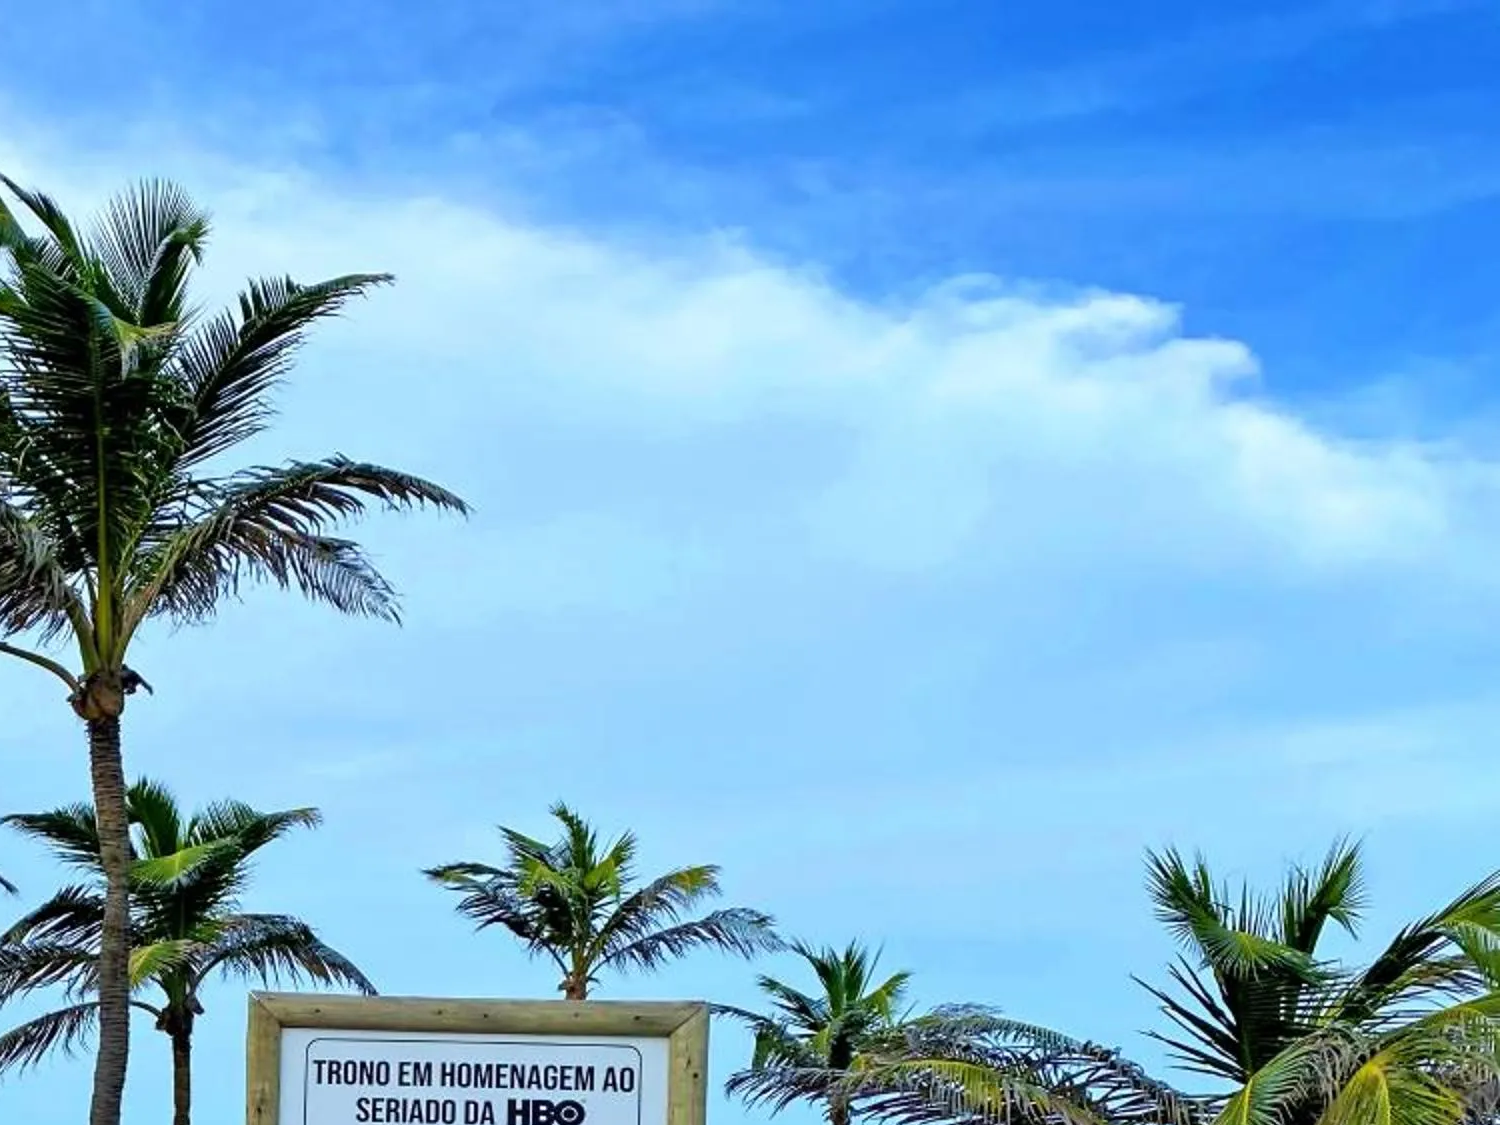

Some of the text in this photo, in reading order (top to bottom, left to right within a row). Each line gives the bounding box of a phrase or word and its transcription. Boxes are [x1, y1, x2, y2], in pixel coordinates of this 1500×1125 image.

[313, 1060, 635, 1092] TRONO EM HOMENAGEM AO
[356, 1098, 457, 1125] SERIADO
[464, 1100, 495, 1125] DA
